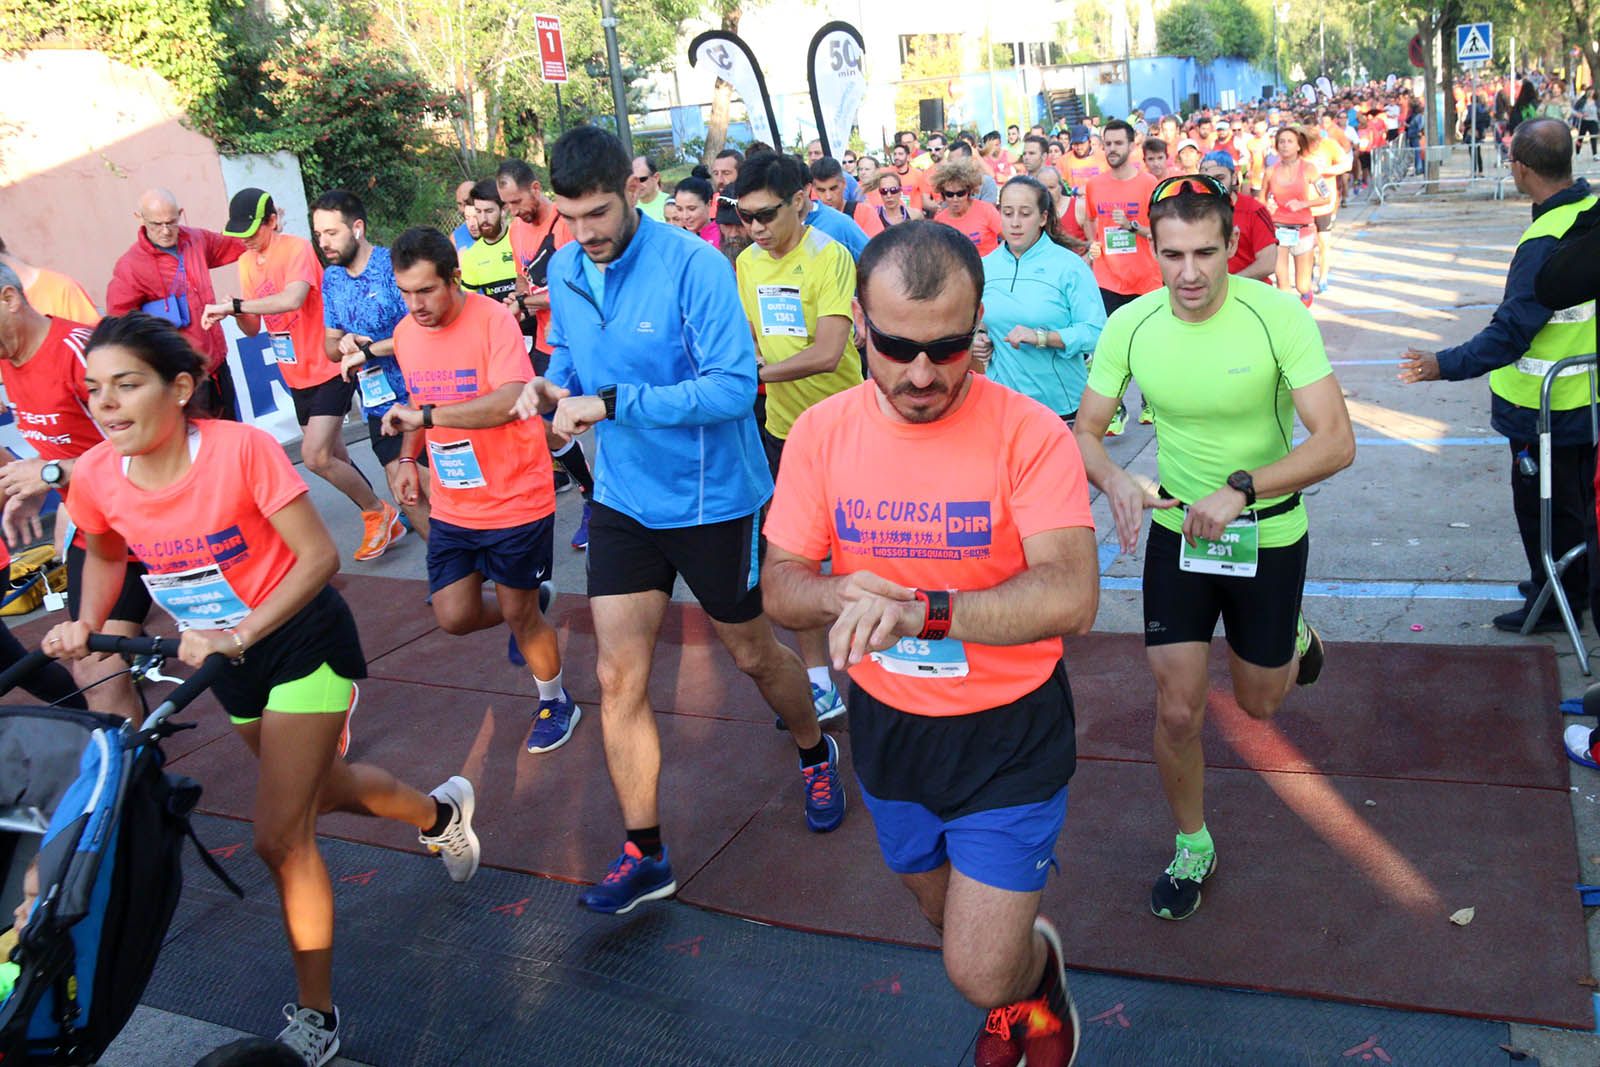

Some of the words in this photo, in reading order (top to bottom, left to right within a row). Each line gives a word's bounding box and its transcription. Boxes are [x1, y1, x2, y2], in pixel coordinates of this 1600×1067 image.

[546, 31, 555, 53] 1
[876, 500, 943, 523] CURSA
[947, 515, 990, 534] DiR
[154, 537, 204, 558] CURSA
[1206, 542, 1233, 557] 291
